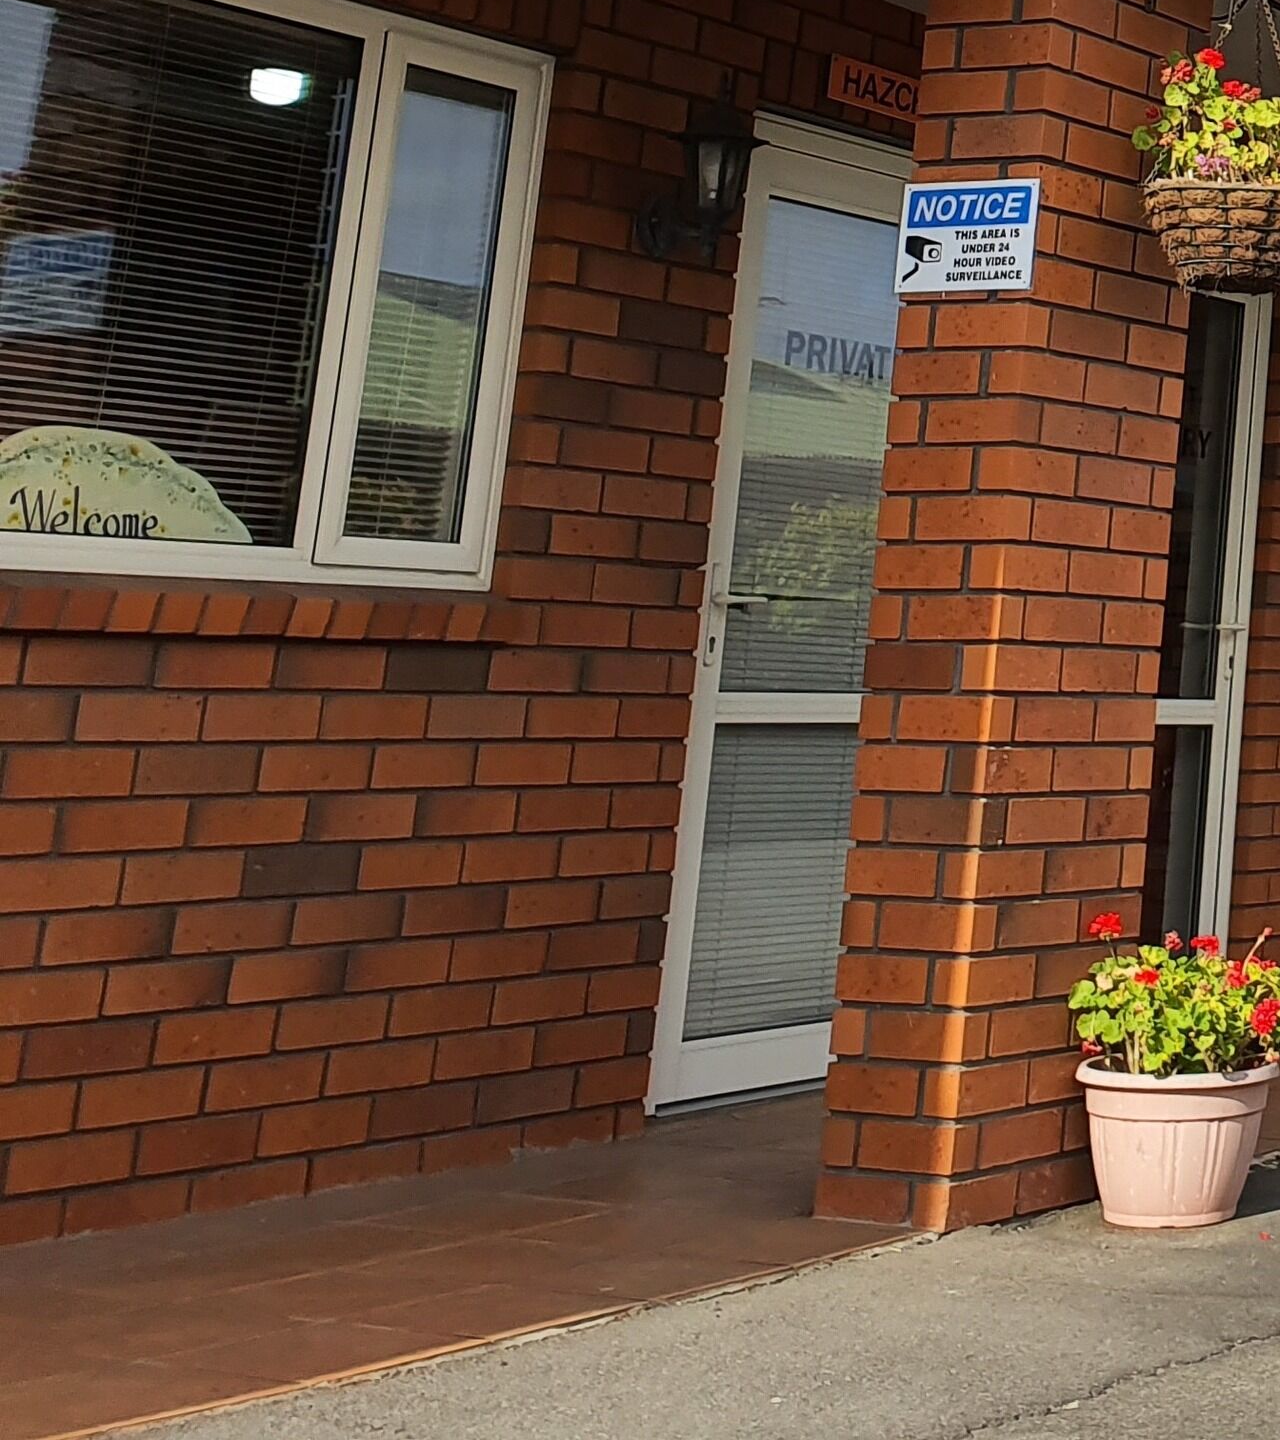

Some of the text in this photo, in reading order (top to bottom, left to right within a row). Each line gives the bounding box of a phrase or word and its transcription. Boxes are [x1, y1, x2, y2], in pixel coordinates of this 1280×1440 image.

[913, 191, 1026, 223] NOTICE
[954, 228, 1020, 241] THIS AREA IS
[961, 242, 1010, 254] UNDER 24
[953, 256, 1016, 268] HOUR VIDEO
[945, 270, 1022, 282] SURVEILLANCE
[784, 329, 893, 380] PRIVAT
[9, 484, 159, 538] Welcome
